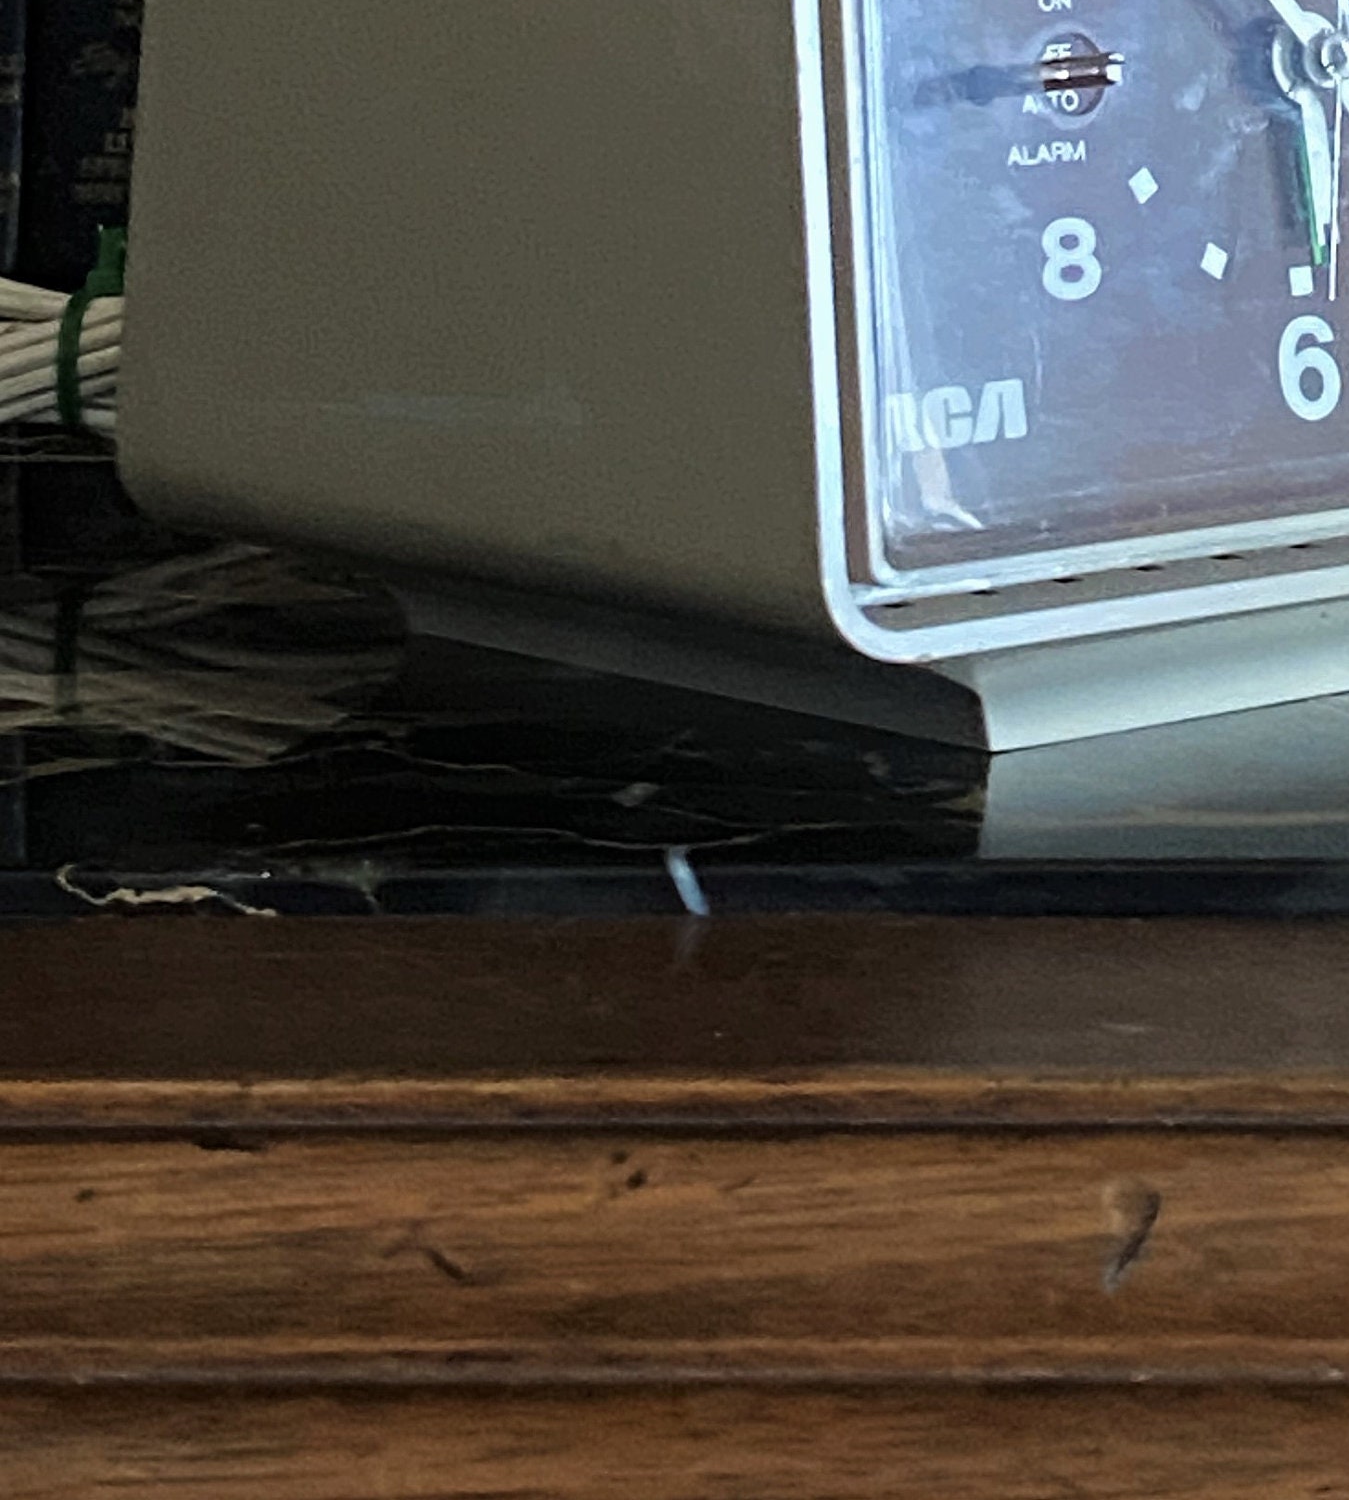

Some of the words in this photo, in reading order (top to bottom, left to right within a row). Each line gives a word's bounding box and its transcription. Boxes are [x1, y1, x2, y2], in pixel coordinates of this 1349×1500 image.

[1007, 139, 1087, 167] ALARM
[1041, 216, 1102, 301] 8
[1278, 315, 1342, 421] 6
